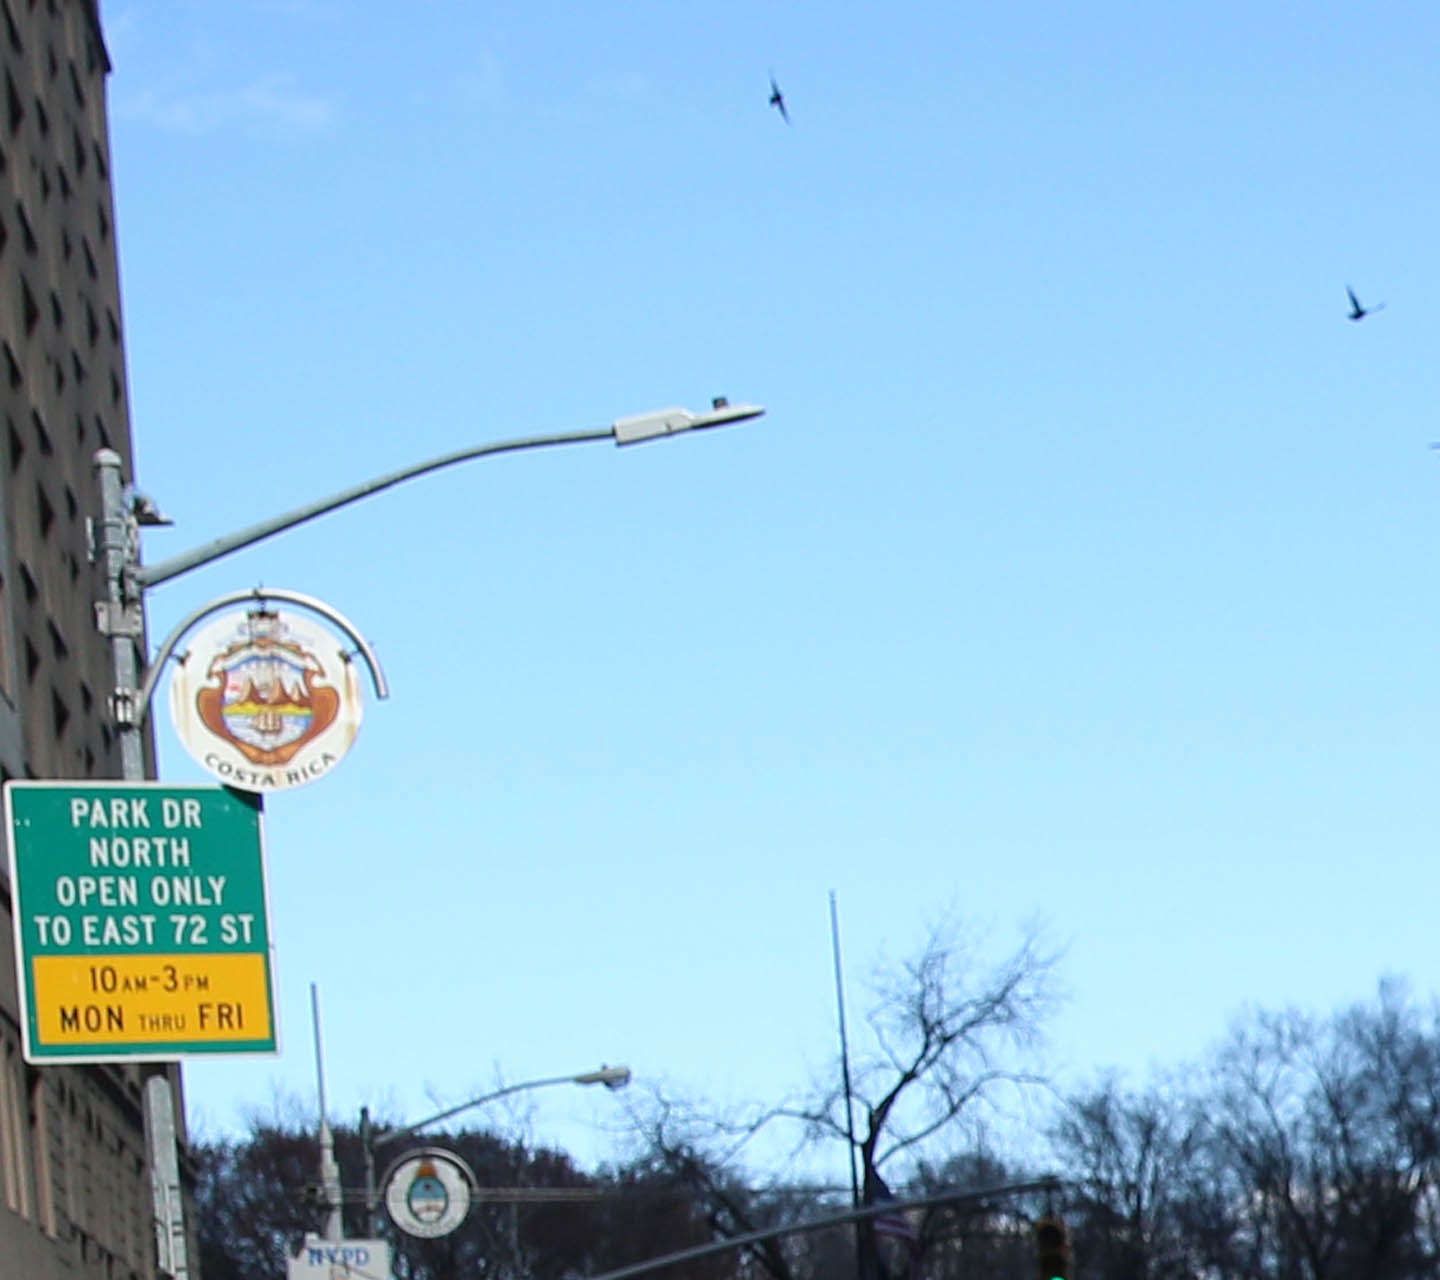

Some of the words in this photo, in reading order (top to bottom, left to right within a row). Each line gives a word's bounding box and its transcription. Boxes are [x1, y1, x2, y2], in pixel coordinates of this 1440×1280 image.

[205, 752, 276, 787] COSTA
[286, 751, 337, 787] RICA
[70, 798, 150, 829] PARK
[162, 798, 202, 829] DR
[89, 836, 191, 868] NORTH
[56, 876, 138, 907] OPEN
[151, 875, 227, 906] ONLY
[33, 914, 72, 946] TO
[82, 914, 156, 945] EAST
[170, 914, 208, 945] 72
[221, 914, 255, 944] ST
[60, 1006, 125, 1033] MON
[139, 1014, 187, 1032] THRU
[198, 1003, 244, 1031] FRI
[307, 1248, 370, 1267] NYPD
